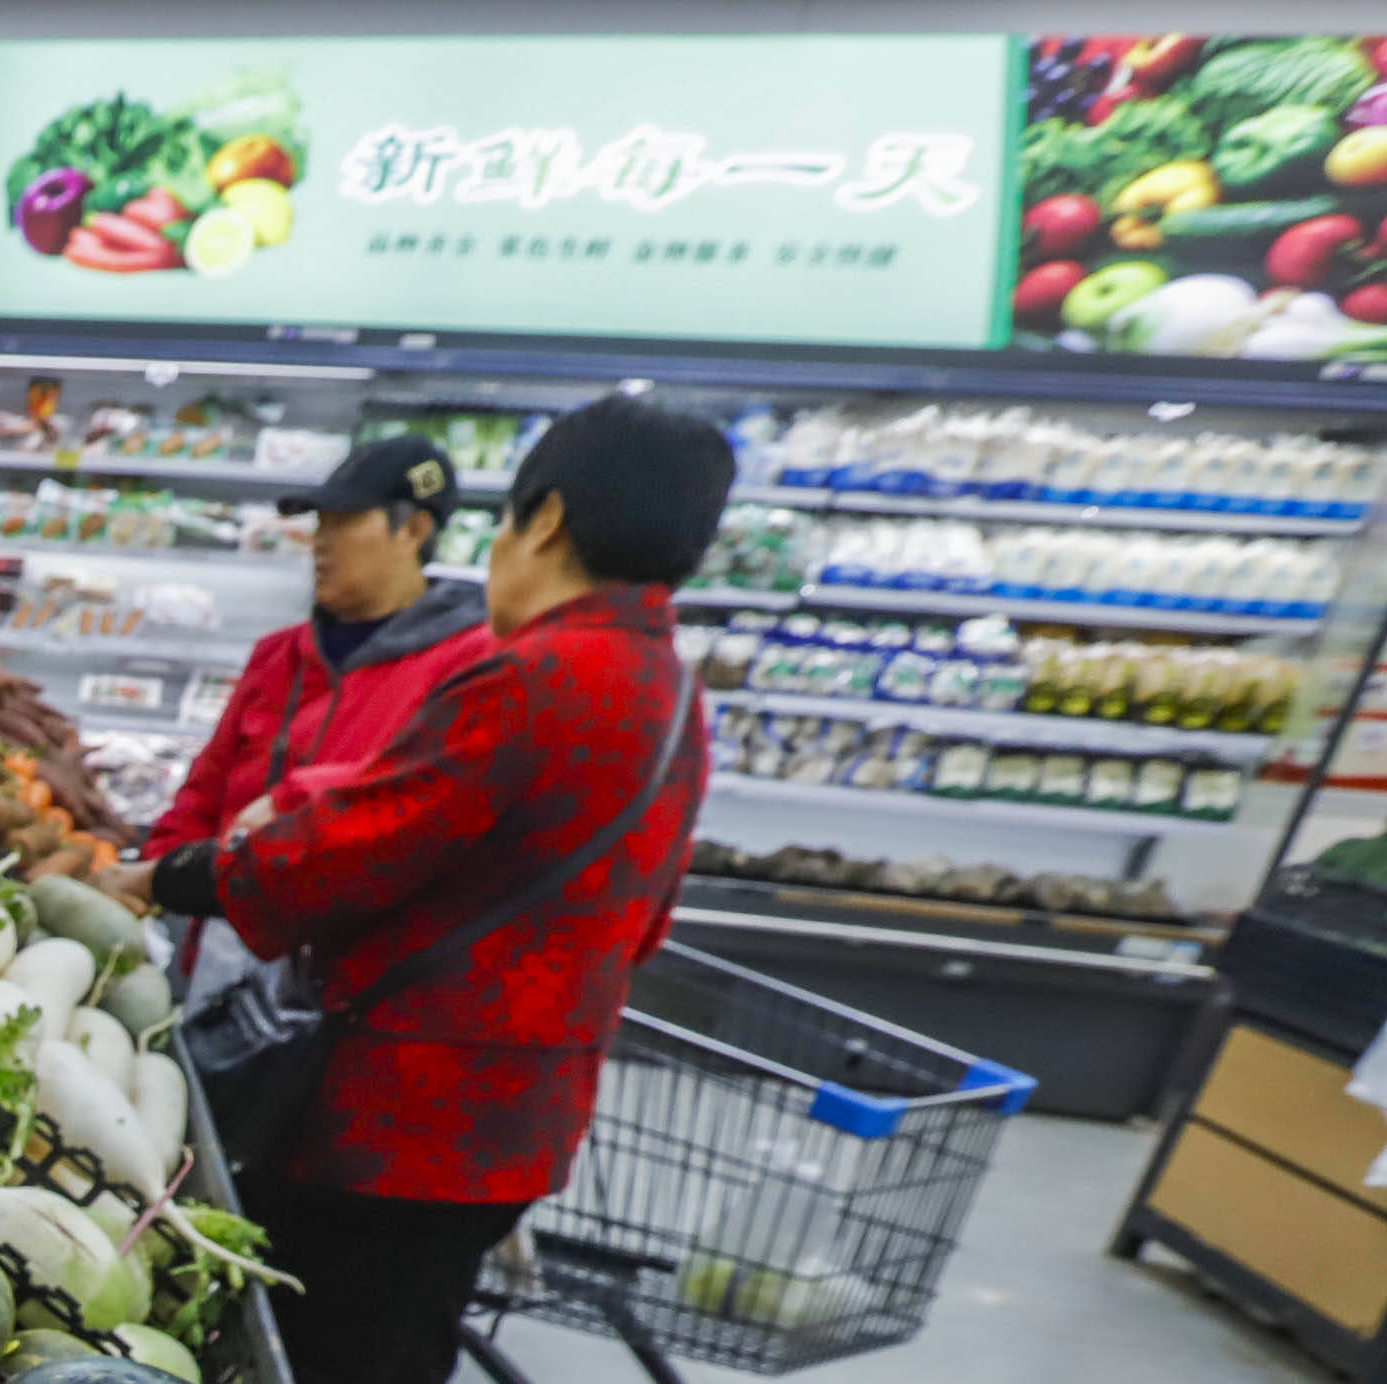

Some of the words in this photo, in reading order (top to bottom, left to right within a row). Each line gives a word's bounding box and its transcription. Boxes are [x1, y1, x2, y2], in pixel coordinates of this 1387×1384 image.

[349, 128, 973, 208] 新鲜每一天
